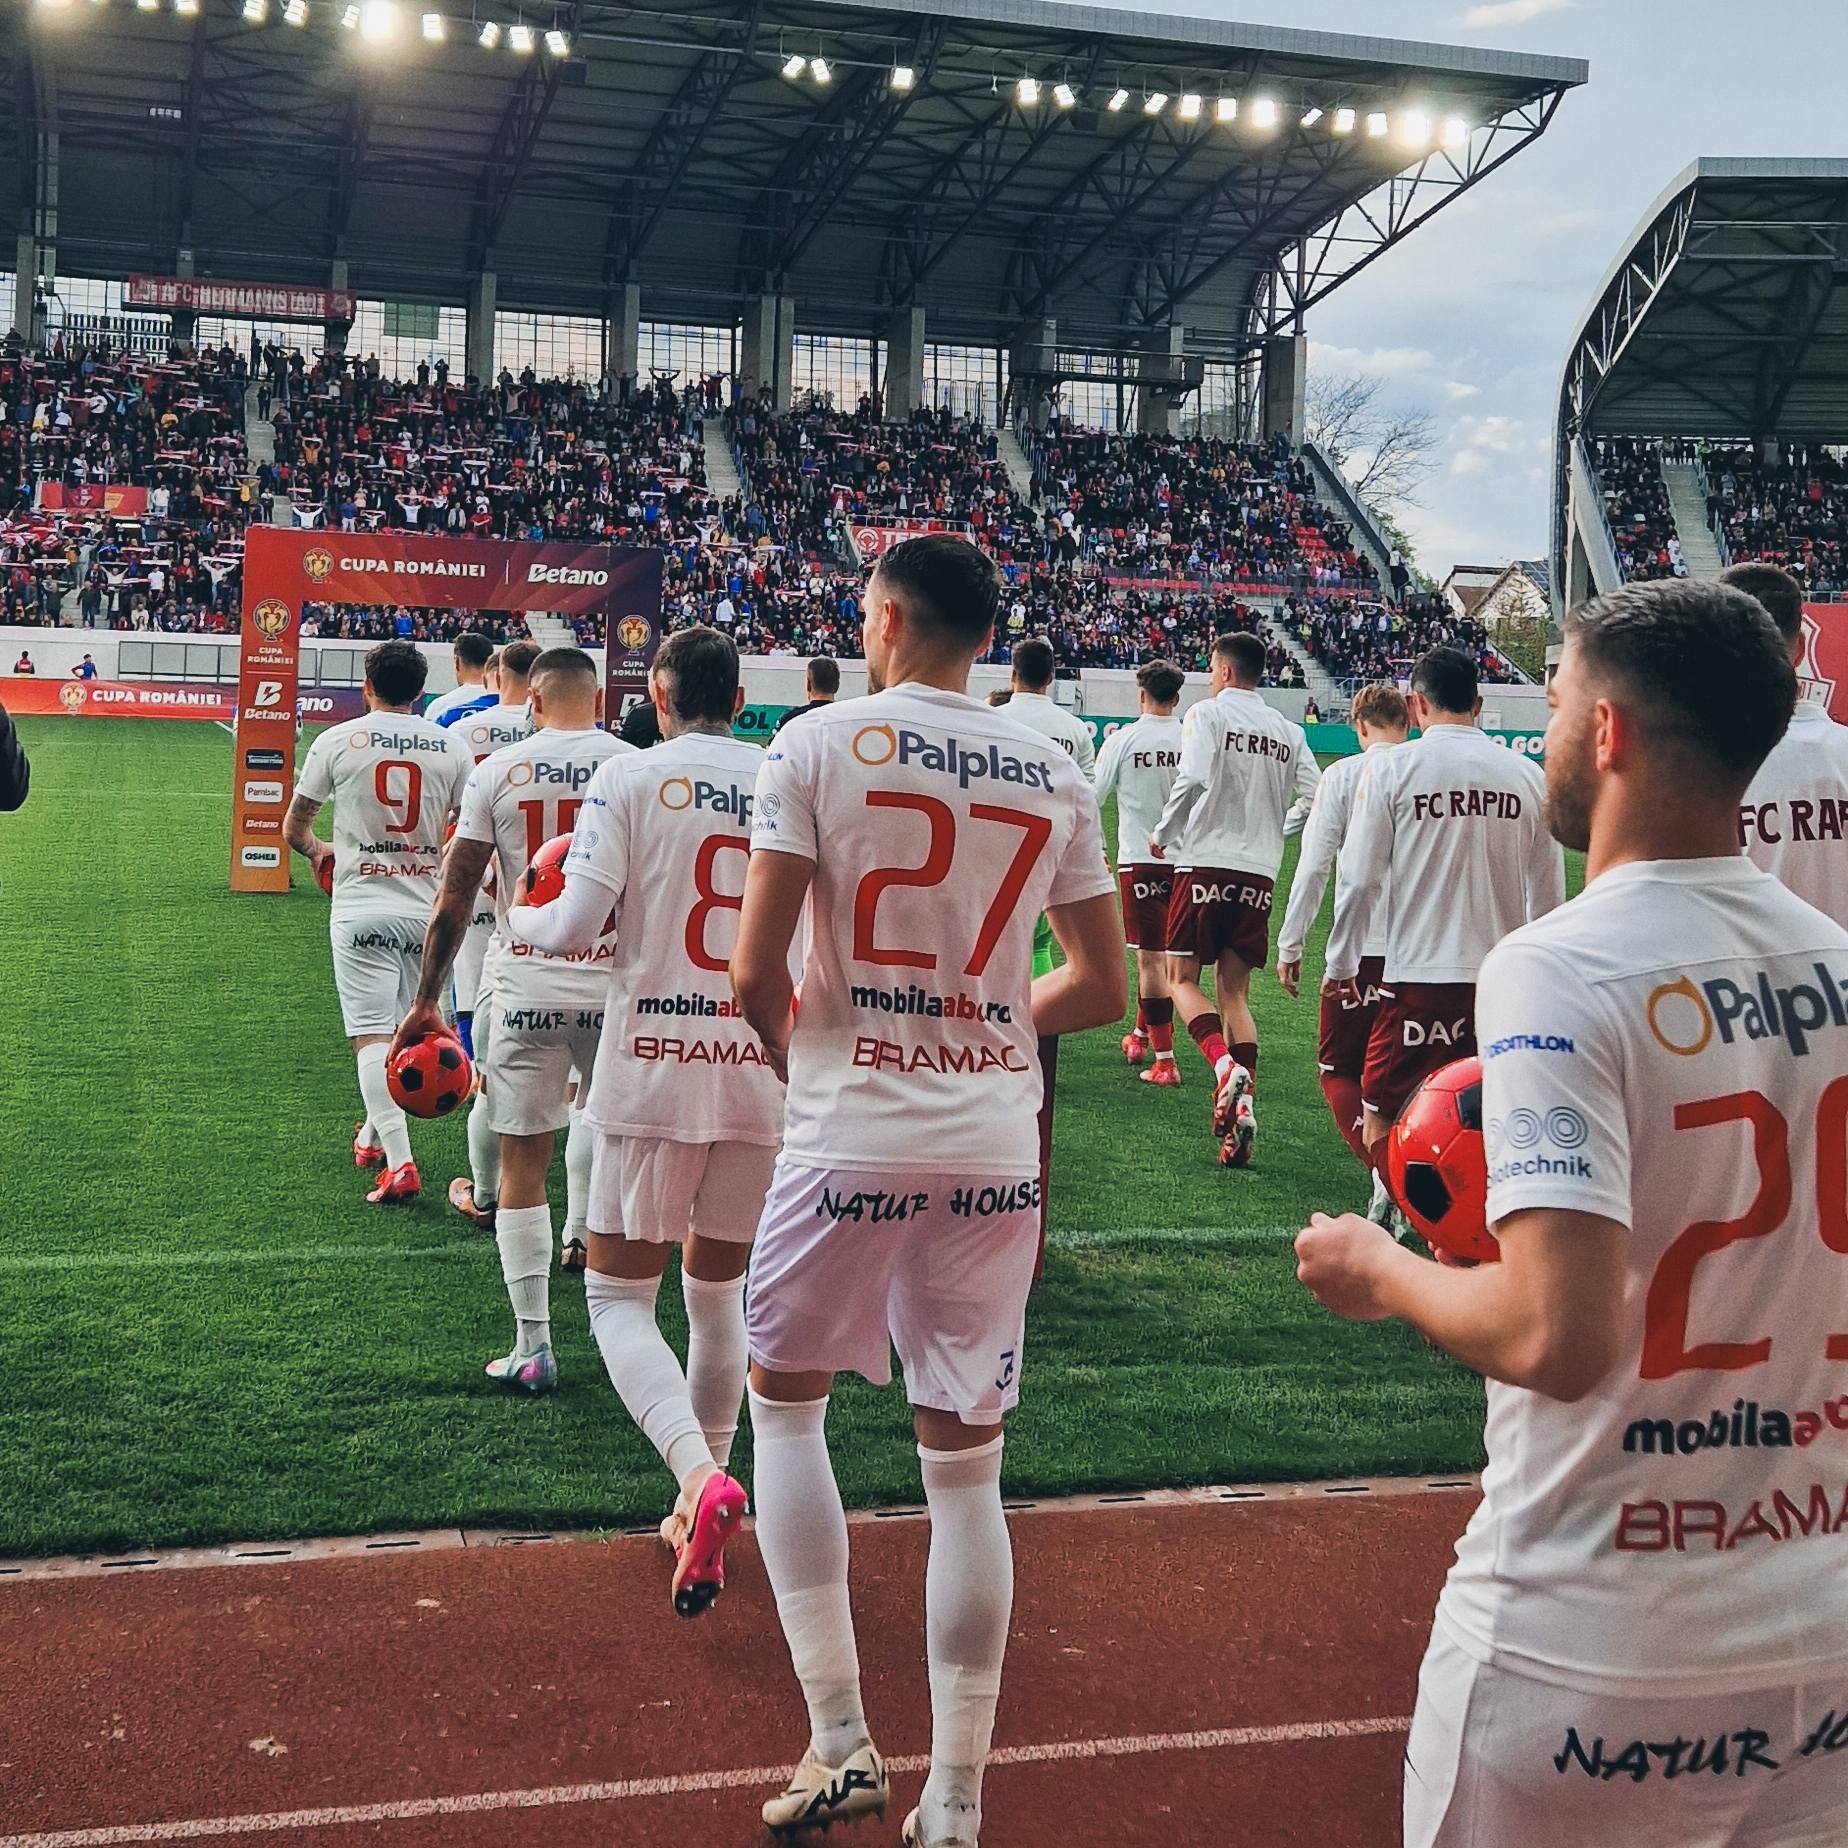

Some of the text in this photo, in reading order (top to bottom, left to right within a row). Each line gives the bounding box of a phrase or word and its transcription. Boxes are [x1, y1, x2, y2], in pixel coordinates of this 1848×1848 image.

[340, 558, 609, 586] CUPA ROMÂNIEI Betano
[247, 655, 294, 665] ROMÂNIEI
[259, 647, 283, 655] CUPA
[93, 689, 222, 706] CUPA ROMÂNIEI
[244, 707, 291, 721] Betano
[370, 732, 447, 755] Palplast
[1225, 731, 1291, 763] FC RAPID
[899, 730, 1054, 793] Palplast
[1133, 751, 1153, 769] FC
[247, 787, 280, 797] Pambac
[375, 760, 421, 833] 9
[1413, 789, 1522, 820] FC RAPID
[1738, 802, 1782, 847] FC
[245, 852, 277, 861] OSHEE
[853, 790, 1053, 977] 27
[1134, 880, 1171, 900] DAC
[1191, 884, 1236, 904] DAC
[685, 833, 751, 972] 8
[502, 1009, 567, 1031] NATUR
[852, 1036, 1030, 1074] BRAMAC
[1639, 1074, 1848, 1379] 2
[1615, 1483, 1848, 1552] BRAM
[1553, 1726, 1781, 1782] NATUR
